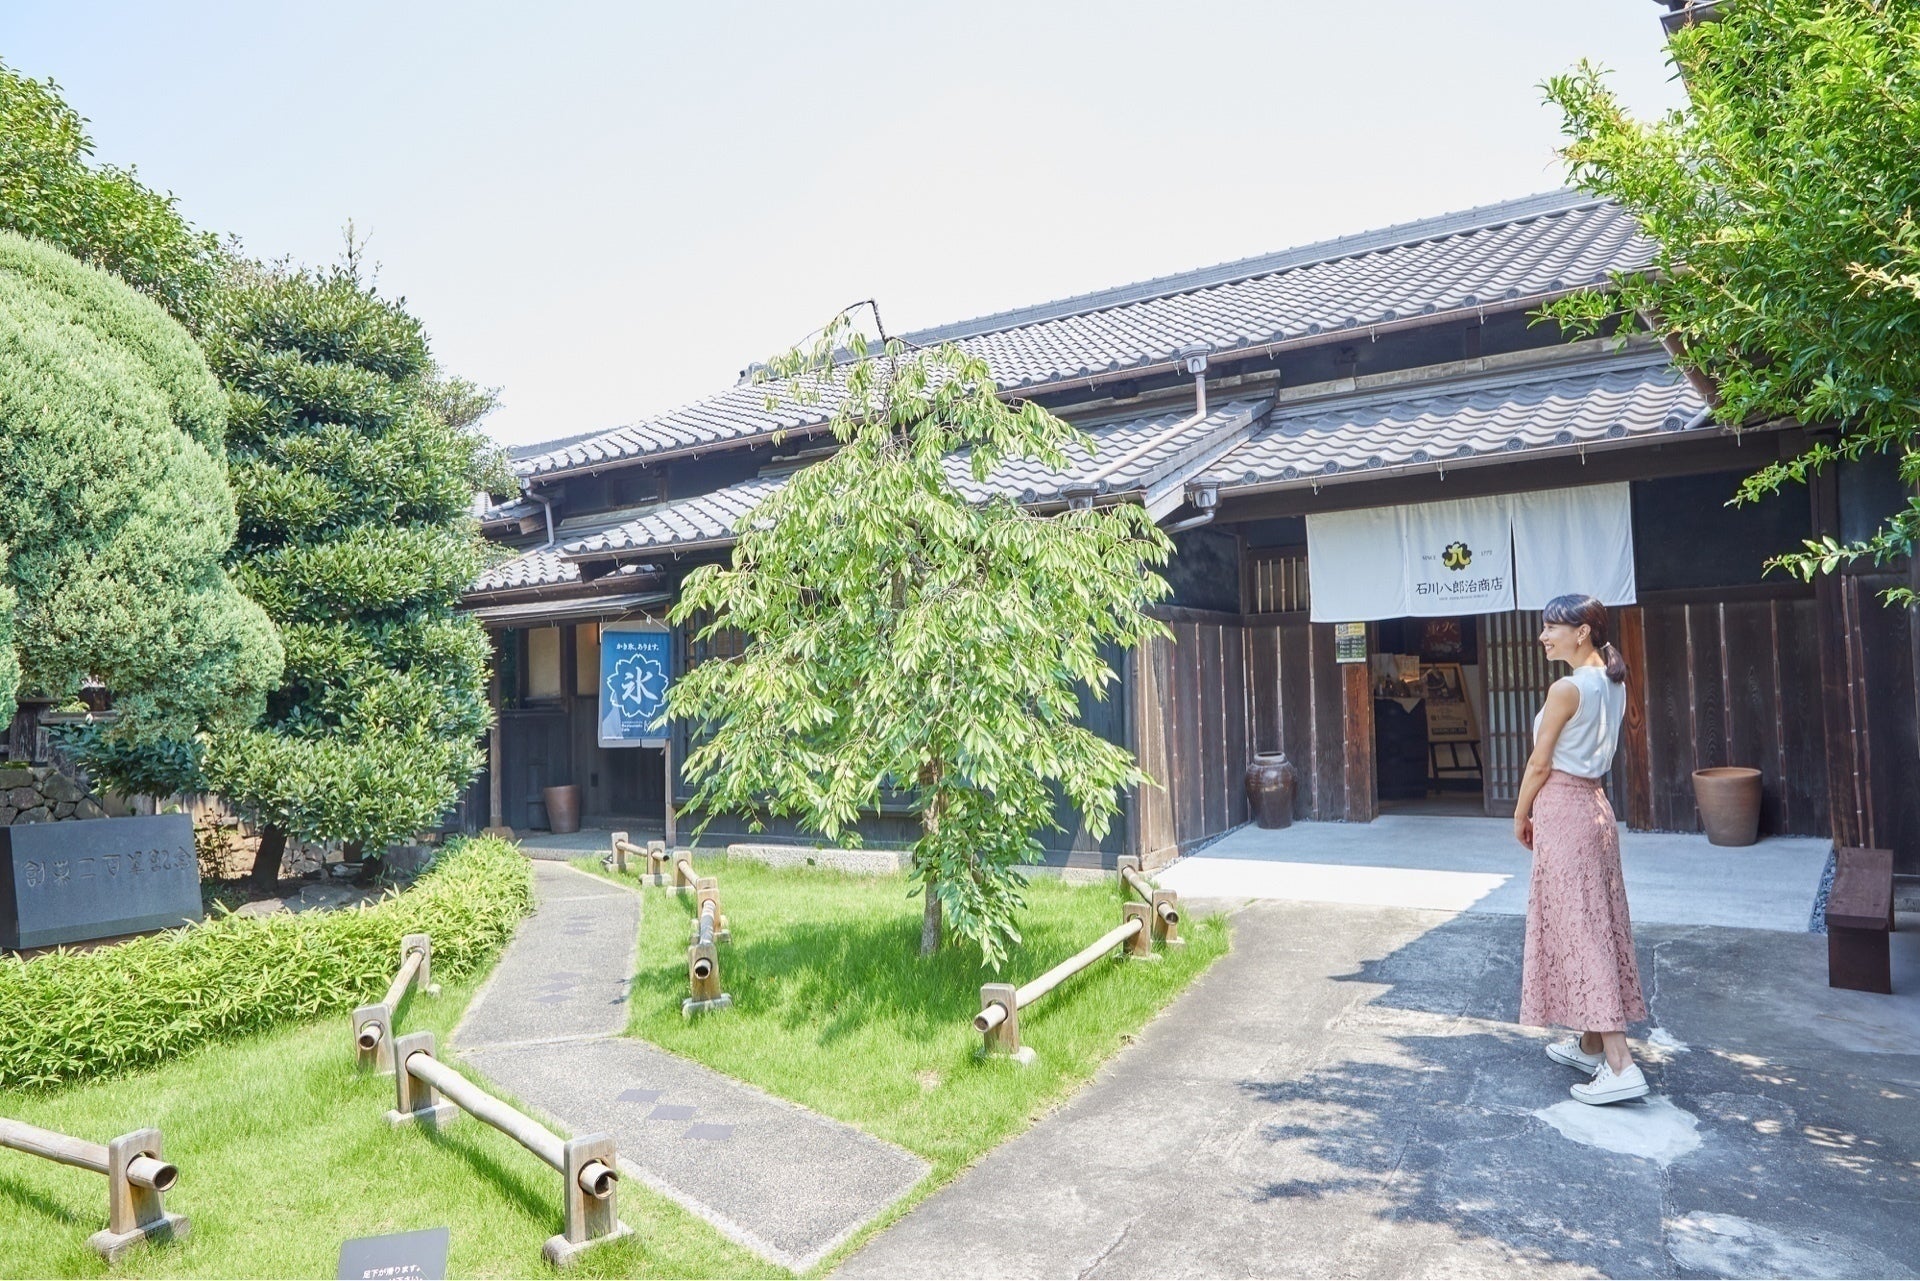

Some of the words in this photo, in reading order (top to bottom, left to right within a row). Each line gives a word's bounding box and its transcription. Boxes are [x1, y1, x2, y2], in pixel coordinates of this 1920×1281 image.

[1416, 576, 1503, 595] 石川八郎治商店
[621, 666, 659, 705] 氷
